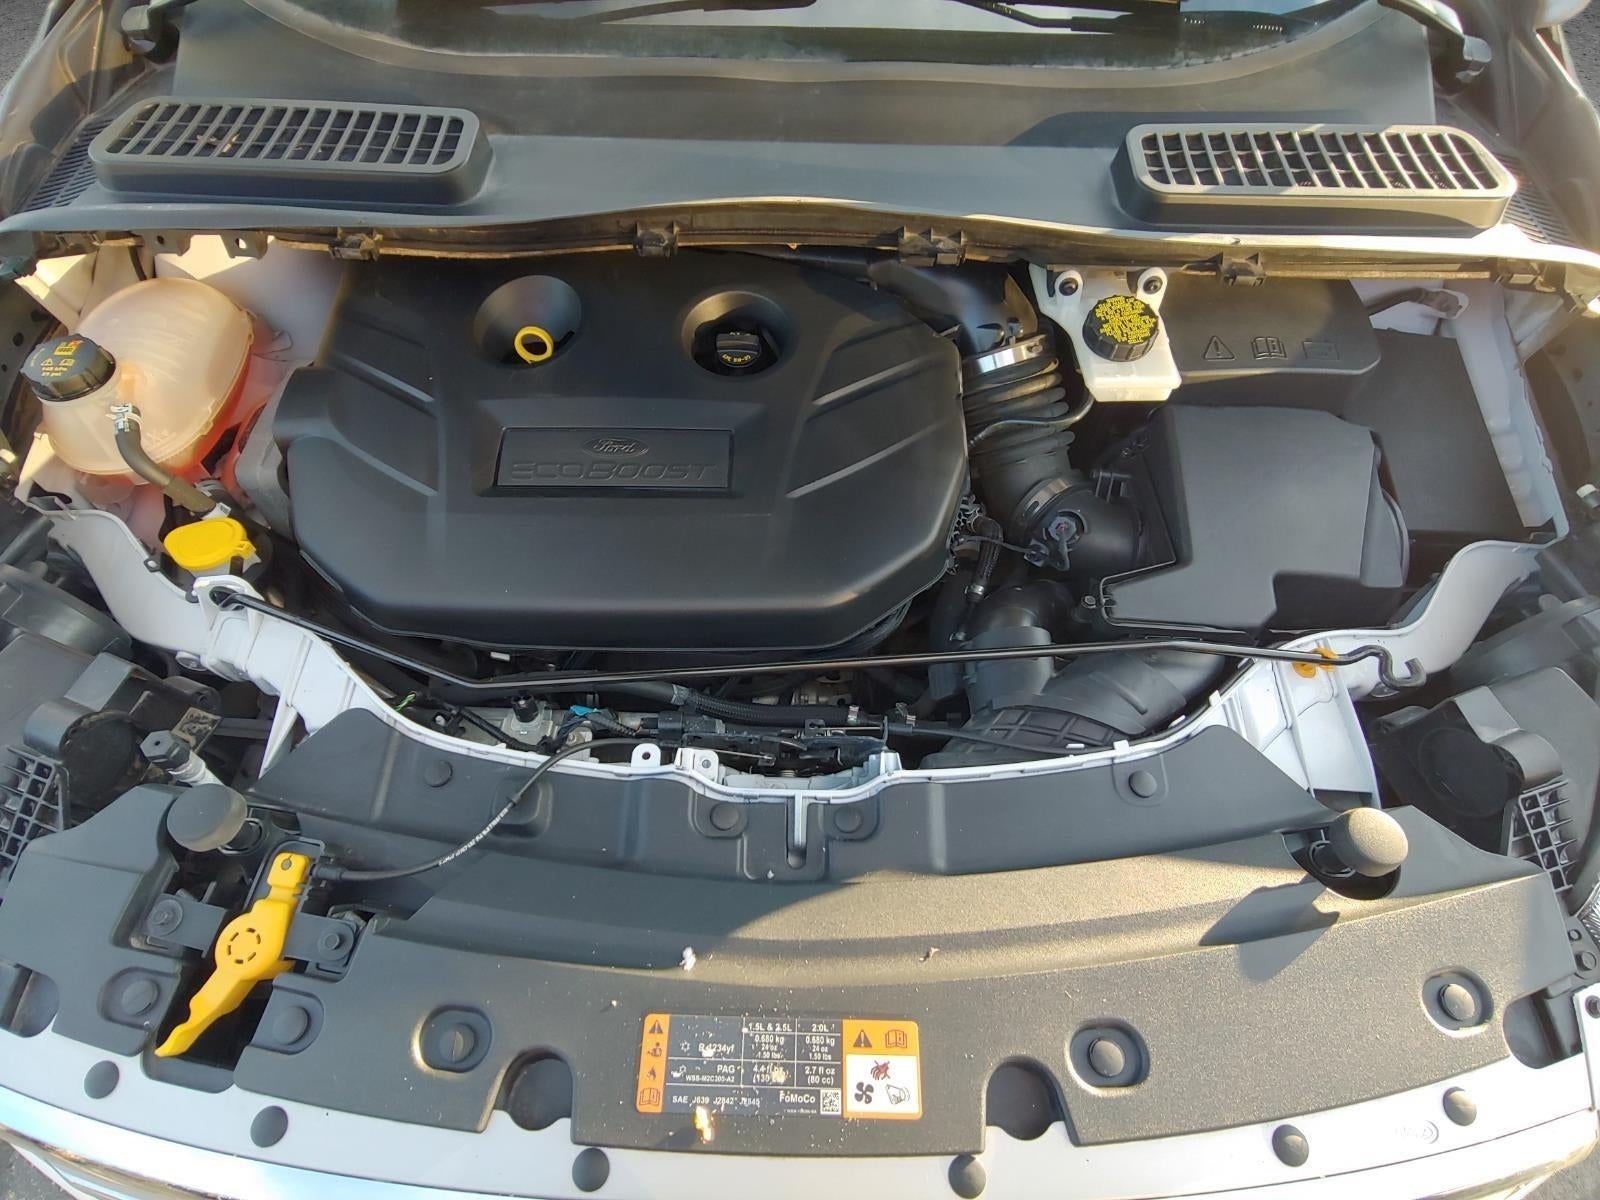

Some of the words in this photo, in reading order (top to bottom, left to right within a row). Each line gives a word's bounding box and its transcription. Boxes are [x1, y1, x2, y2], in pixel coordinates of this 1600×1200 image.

[811, 1023, 829, 1032] 2.0L
[775, 1034, 785, 1045] kg
[826, 1035, 835, 1047] kg
[717, 1064, 736, 1073] PAG
[804, 1065, 817, 1074] 2.7
[825, 1067, 835, 1075] oz
[821, 1075, 834, 1086] cc)
[672, 1095, 688, 1104] SAE
[779, 1092, 816, 1103] FoMoCo
